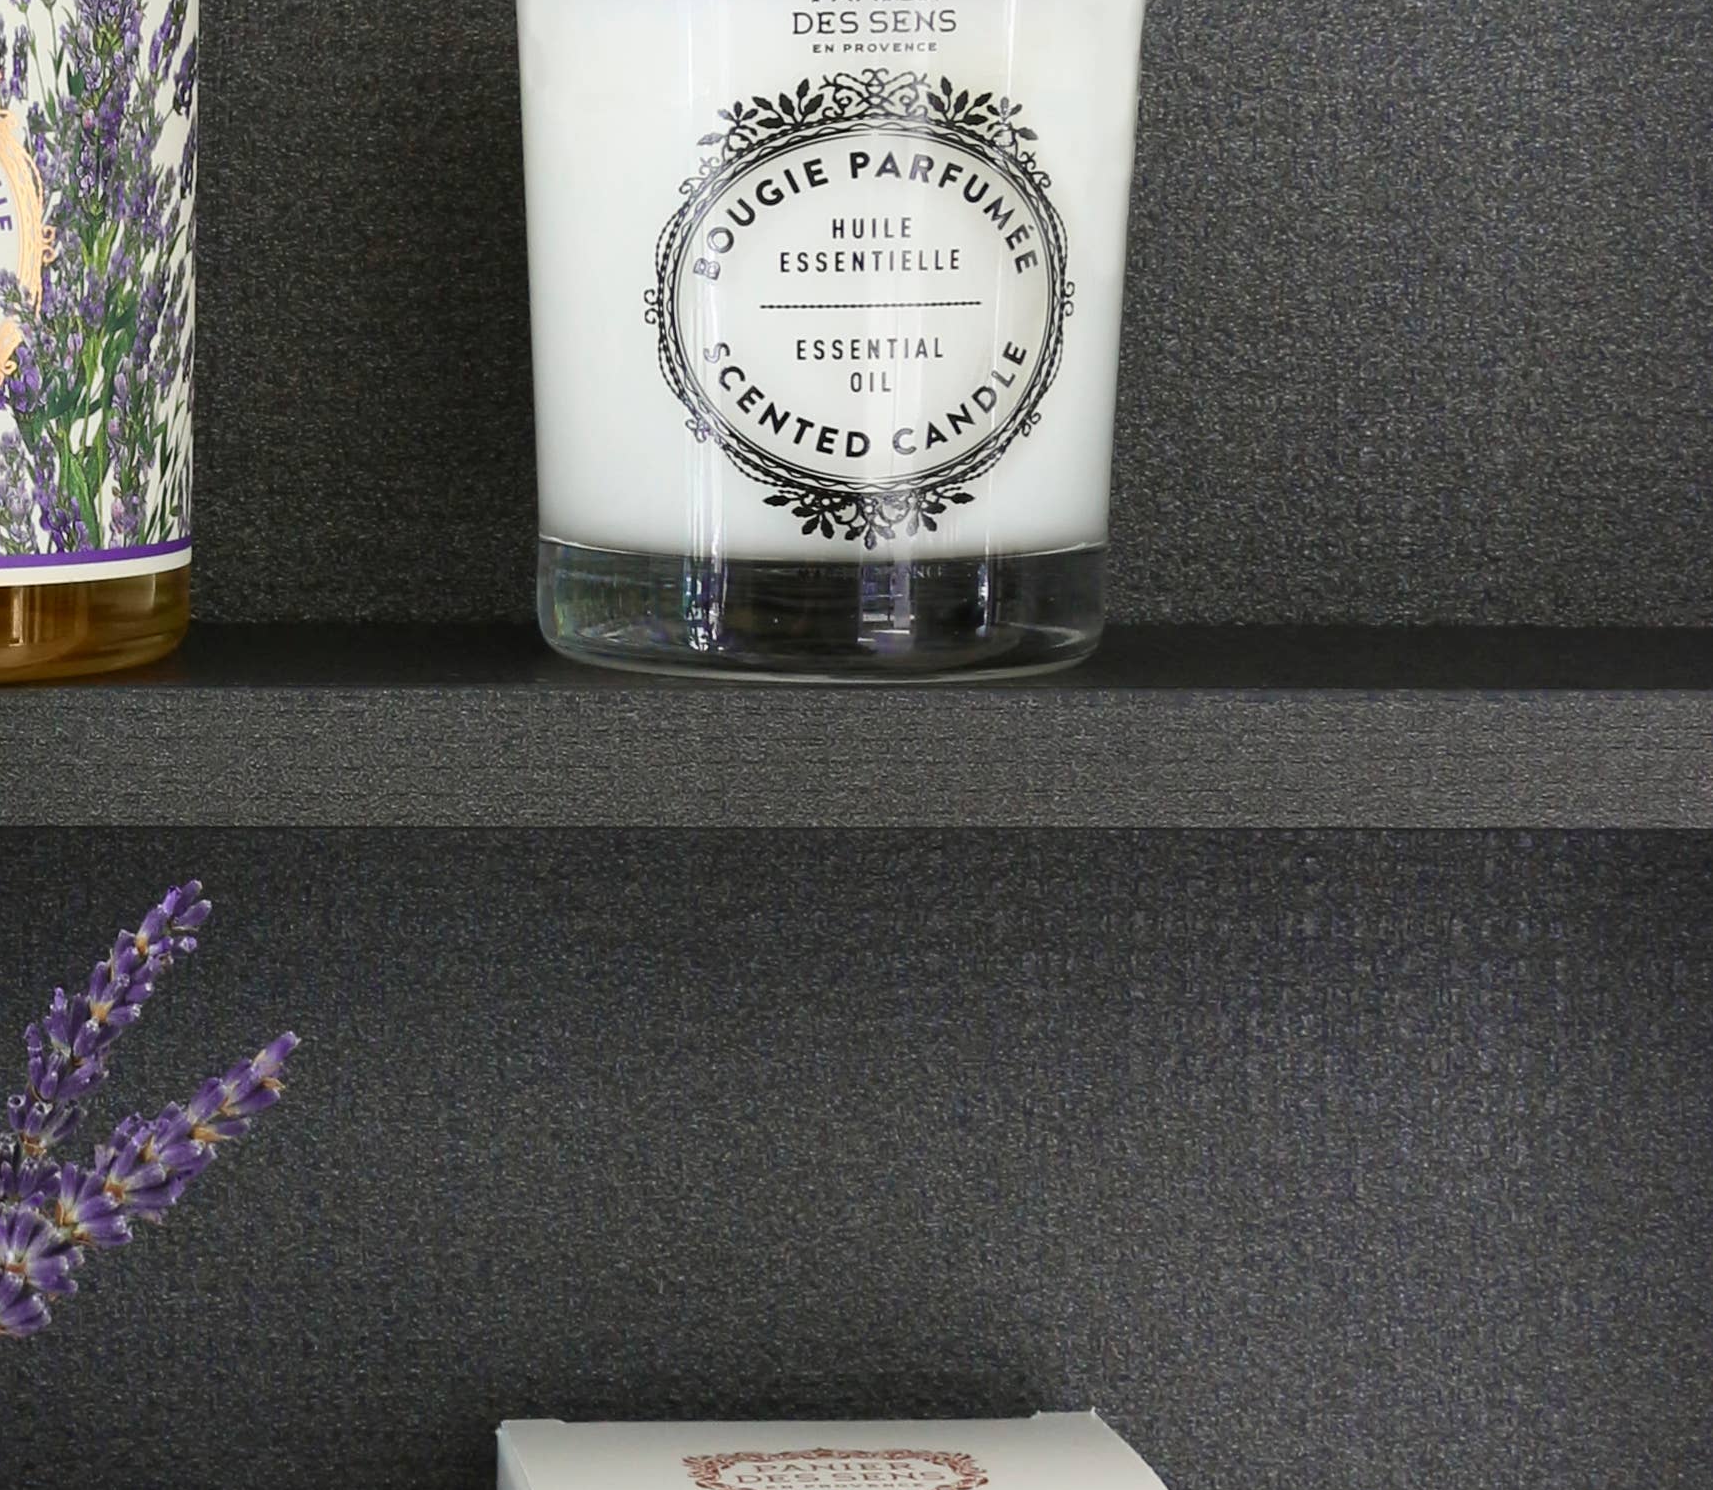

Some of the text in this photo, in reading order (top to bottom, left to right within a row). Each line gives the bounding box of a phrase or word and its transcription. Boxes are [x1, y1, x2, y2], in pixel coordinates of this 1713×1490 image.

[792, 10, 957, 34] DES SENS
[813, 42, 937, 53] EN PROVENCE
[692, 151, 1038, 281] BOUGIE PARFUMÉE
[832, 217, 911, 239] HUILE
[780, 249, 960, 273] ESSENTIELLE
[796, 338, 943, 360] ESSENTIAL
[850, 372, 891, 392] OIL
[703, 341, 1028, 458] SCENTED CANDLE
[737, 1471, 945, 1483] DES SENS
[753, 1462, 911, 1472] PANIER
